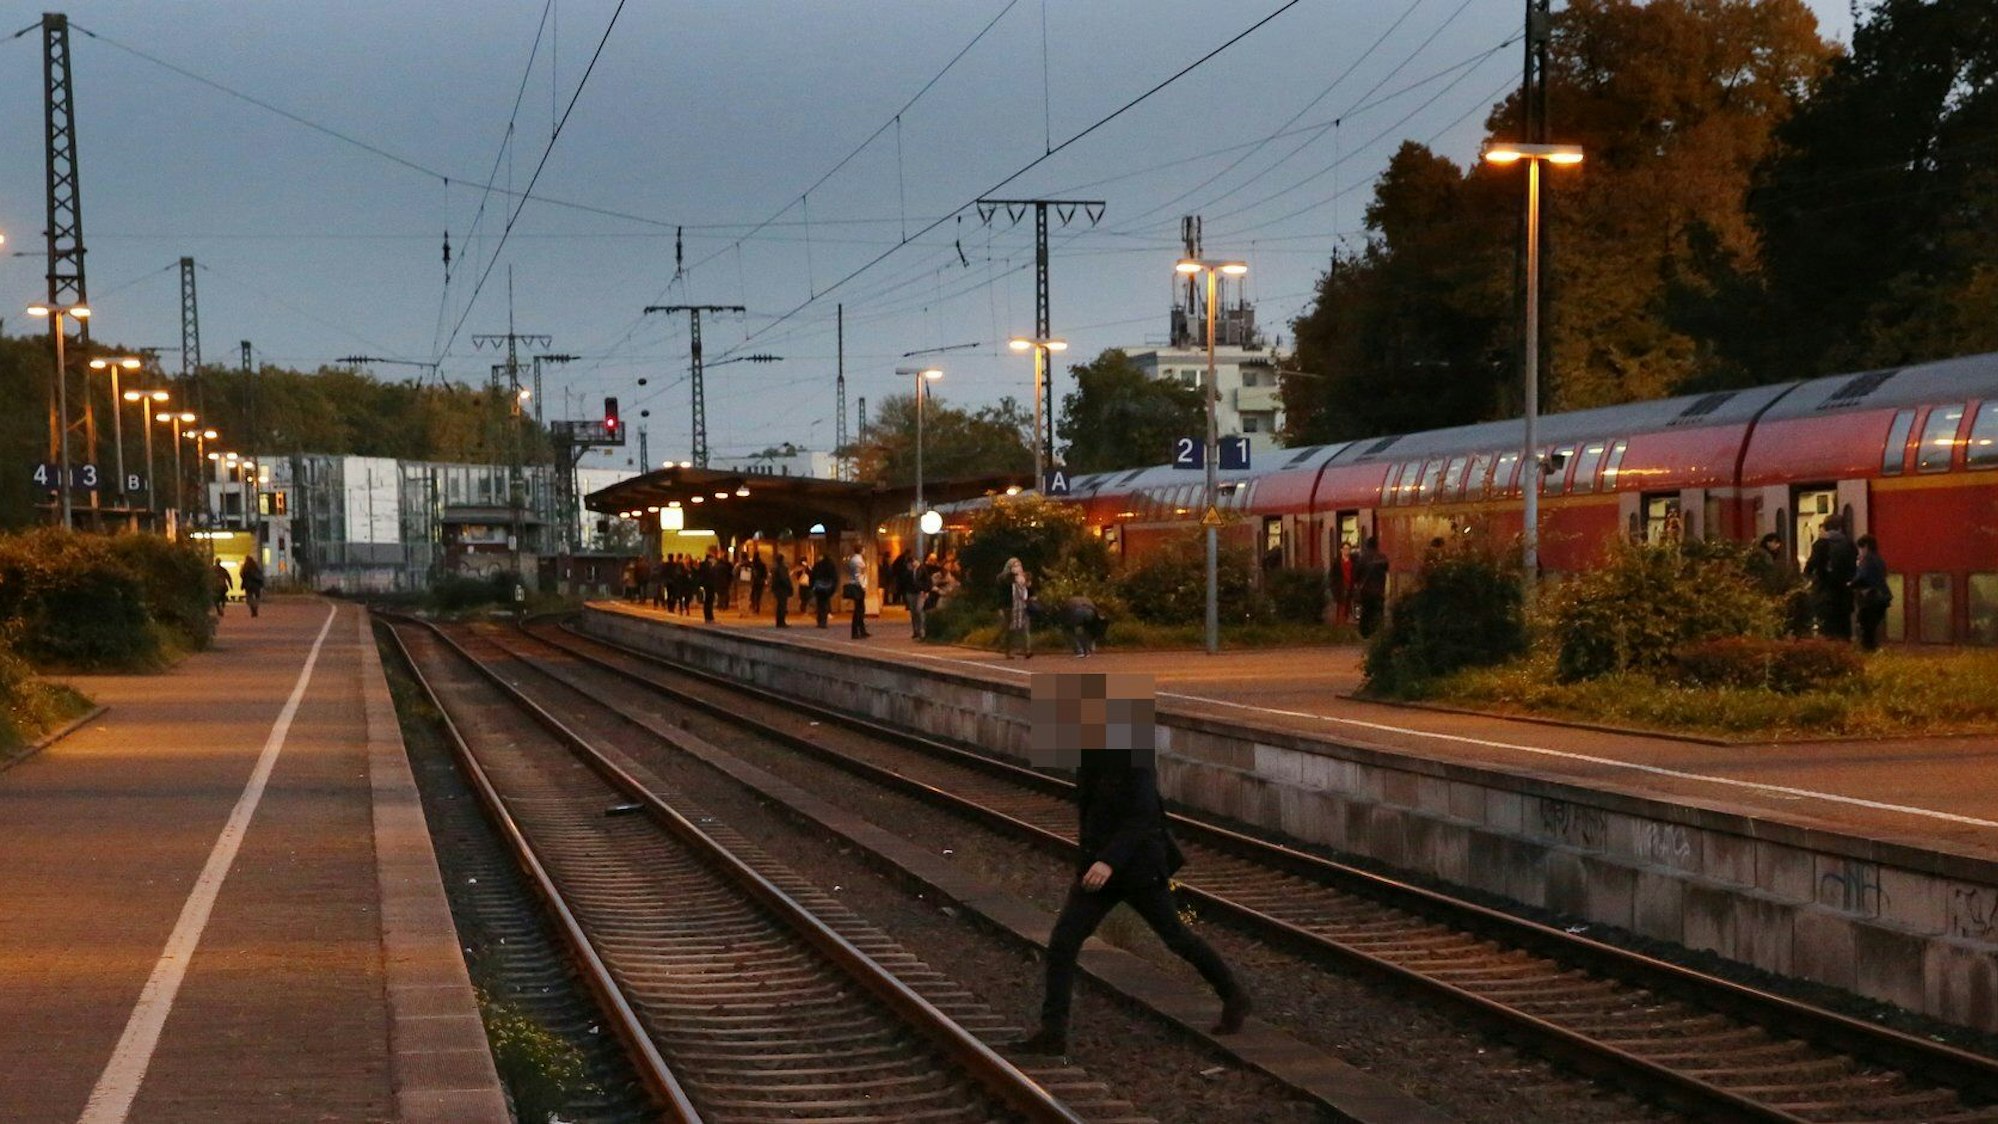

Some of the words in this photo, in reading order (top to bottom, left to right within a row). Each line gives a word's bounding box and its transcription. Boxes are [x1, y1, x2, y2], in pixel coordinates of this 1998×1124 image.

[1178, 438, 1193, 462] 2
[1239, 441, 1247, 462] 1
[33, 464, 48, 484] 4
[83, 465, 97, 485] 3
[128, 475, 139, 490] B
[1051, 472, 1066, 490] A
